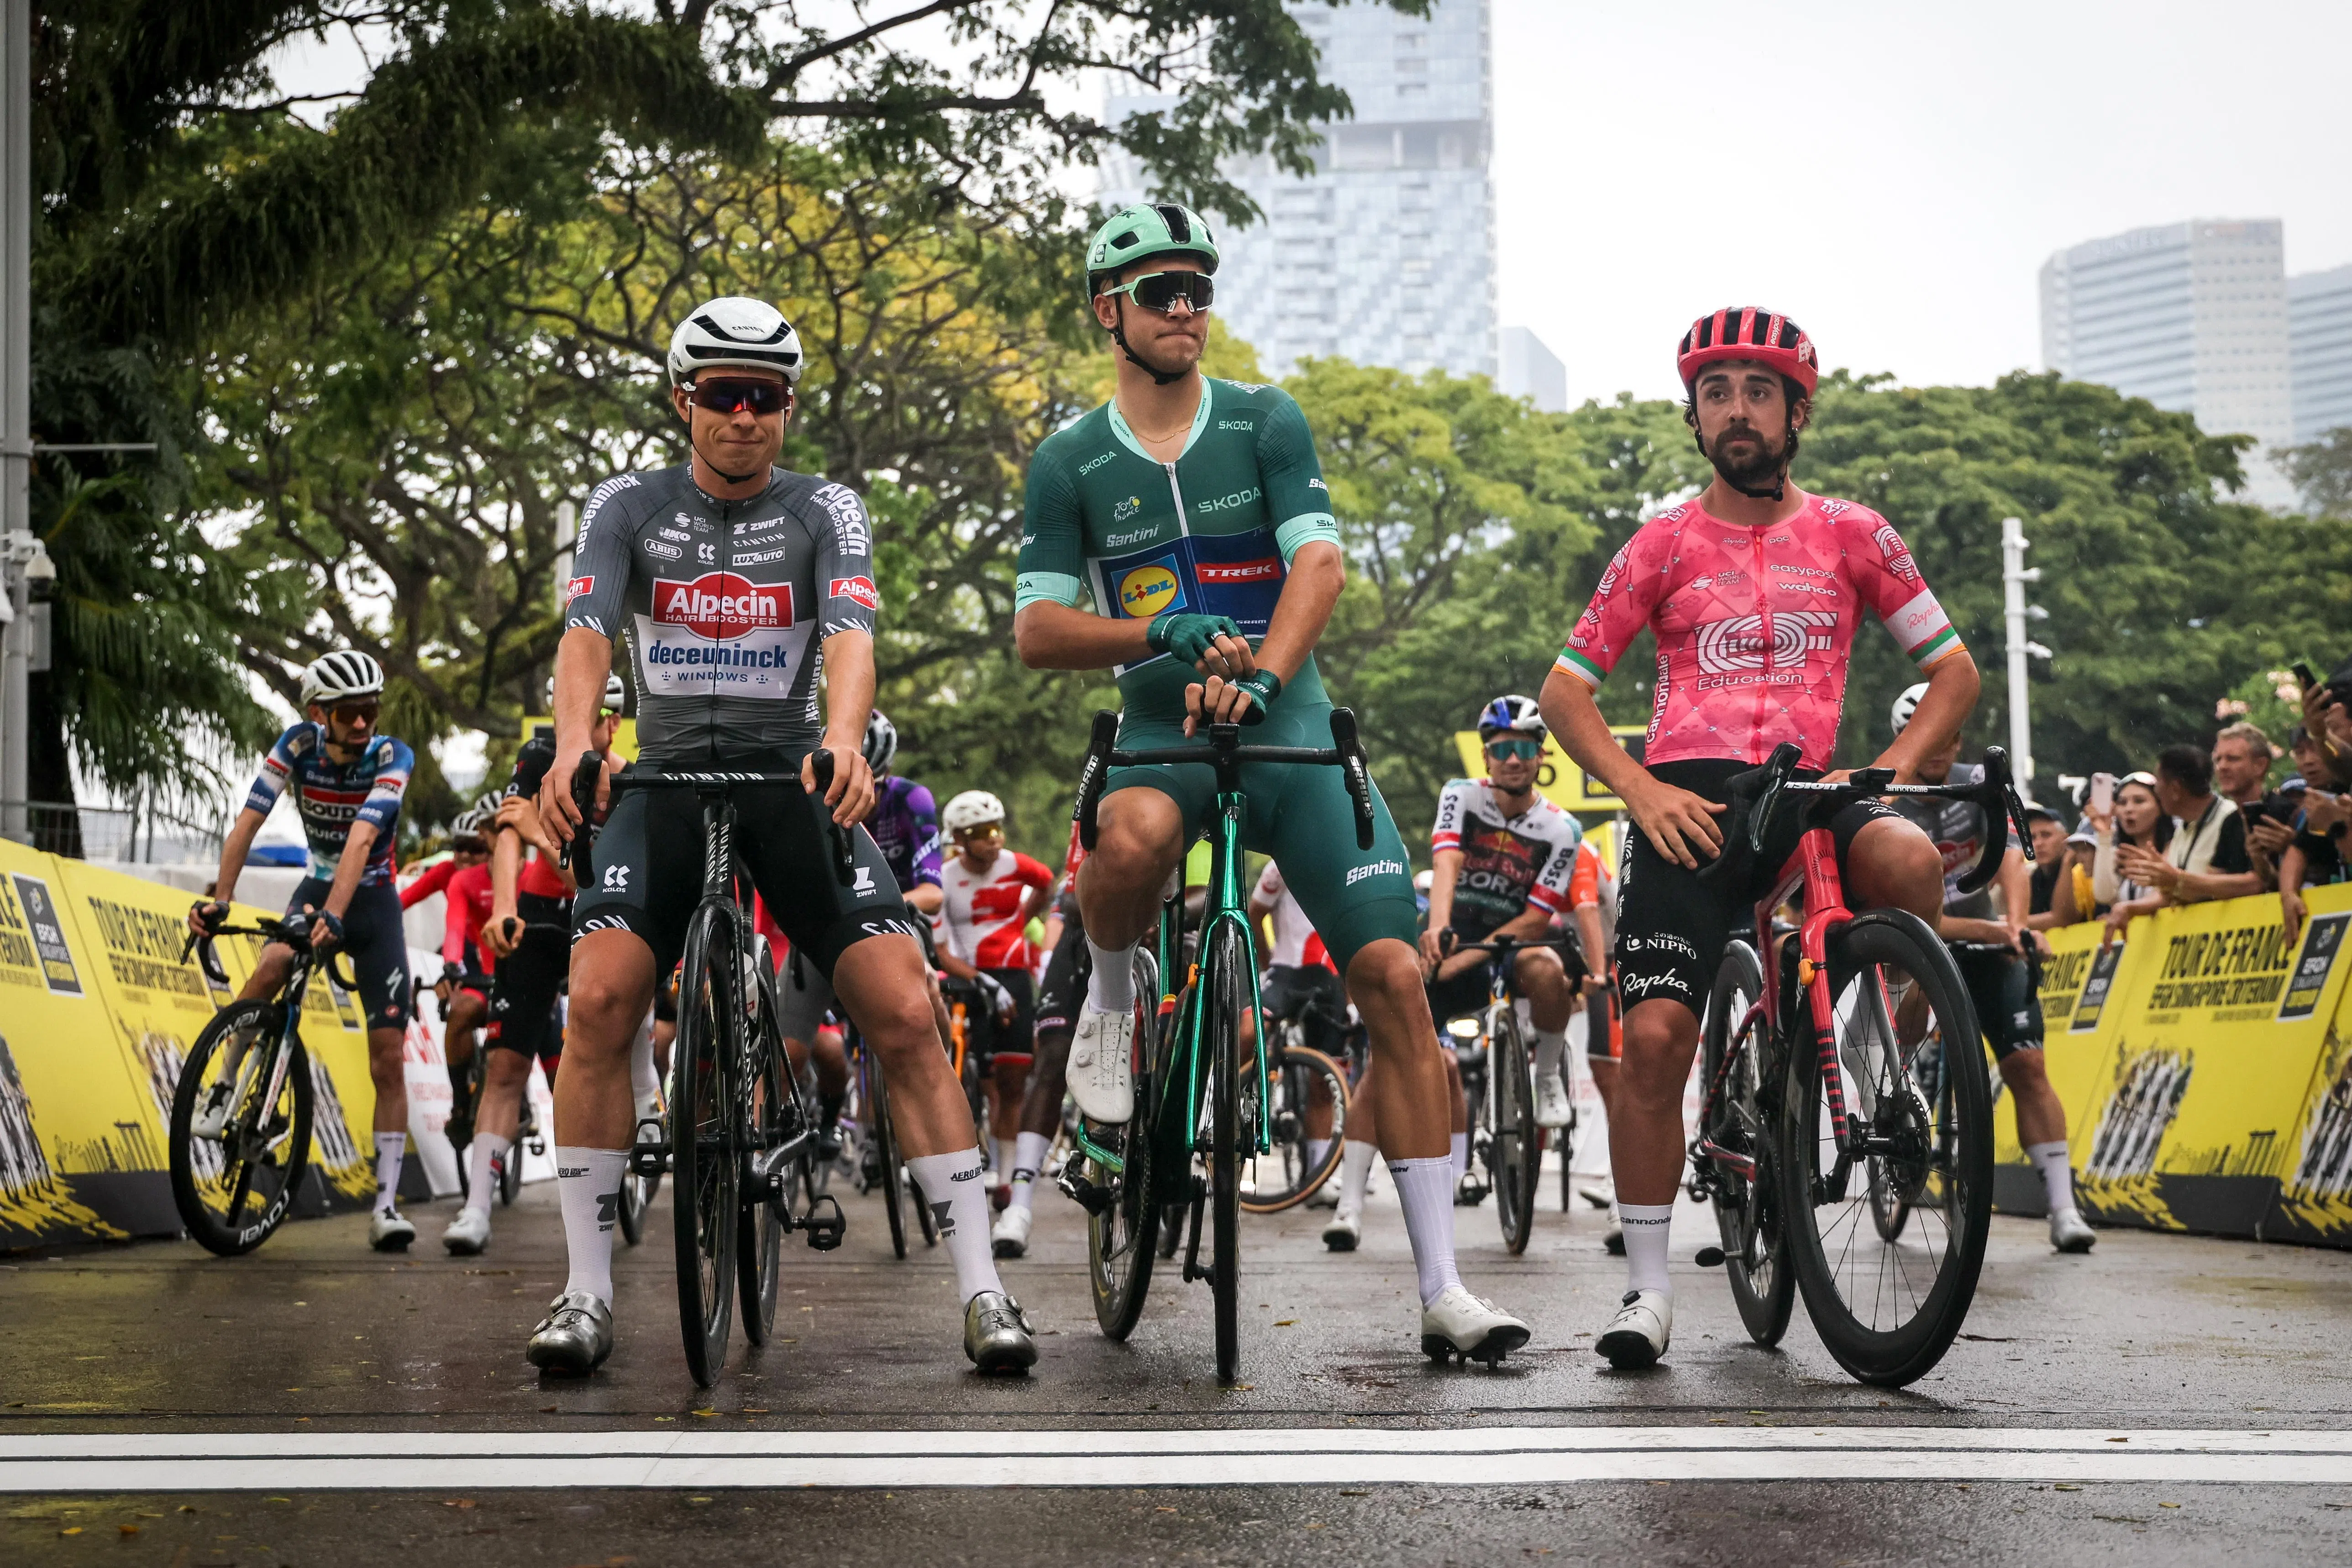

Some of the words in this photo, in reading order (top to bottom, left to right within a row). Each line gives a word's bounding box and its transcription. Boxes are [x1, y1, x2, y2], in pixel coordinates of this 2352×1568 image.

[1770, 315, 1780, 345] easypost
[693, 521, 714, 530] WORLD
[750, 516, 785, 531] ZWIFT
[815, 482, 870, 557] Alpecin
[663, 528, 691, 542] IKO
[693, 525, 709, 534] TEAM
[829, 507, 848, 556] BOOSTER
[1107, 524, 1160, 548] Santini
[733, 533, 786, 547] CANYON
[1020, 534, 1037, 548] tini
[1722, 537, 1748, 545] Rapha
[649, 541, 678, 556] ABUS
[1202, 564, 1272, 577] TREK
[1717, 573, 1747, 582] WORLD
[1769, 564, 1838, 580] easypost
[1778, 582, 1837, 597] wahoo
[666, 587, 777, 622] Alpecin
[666, 614, 698, 622] HAIR
[708, 615, 778, 625] BOOSTER
[649, 640, 787, 668] deceuninck
[677, 671, 749, 682] WINDOWS
[1697, 672, 1804, 692] Education
[1645, 654, 1669, 744] cannondale
[1346, 860, 1402, 886] Santini
[1543, 848, 1574, 887] BOSS
[856, 889, 877, 898] ZWIFT
[1646, 938, 1697, 960] NIPPO
